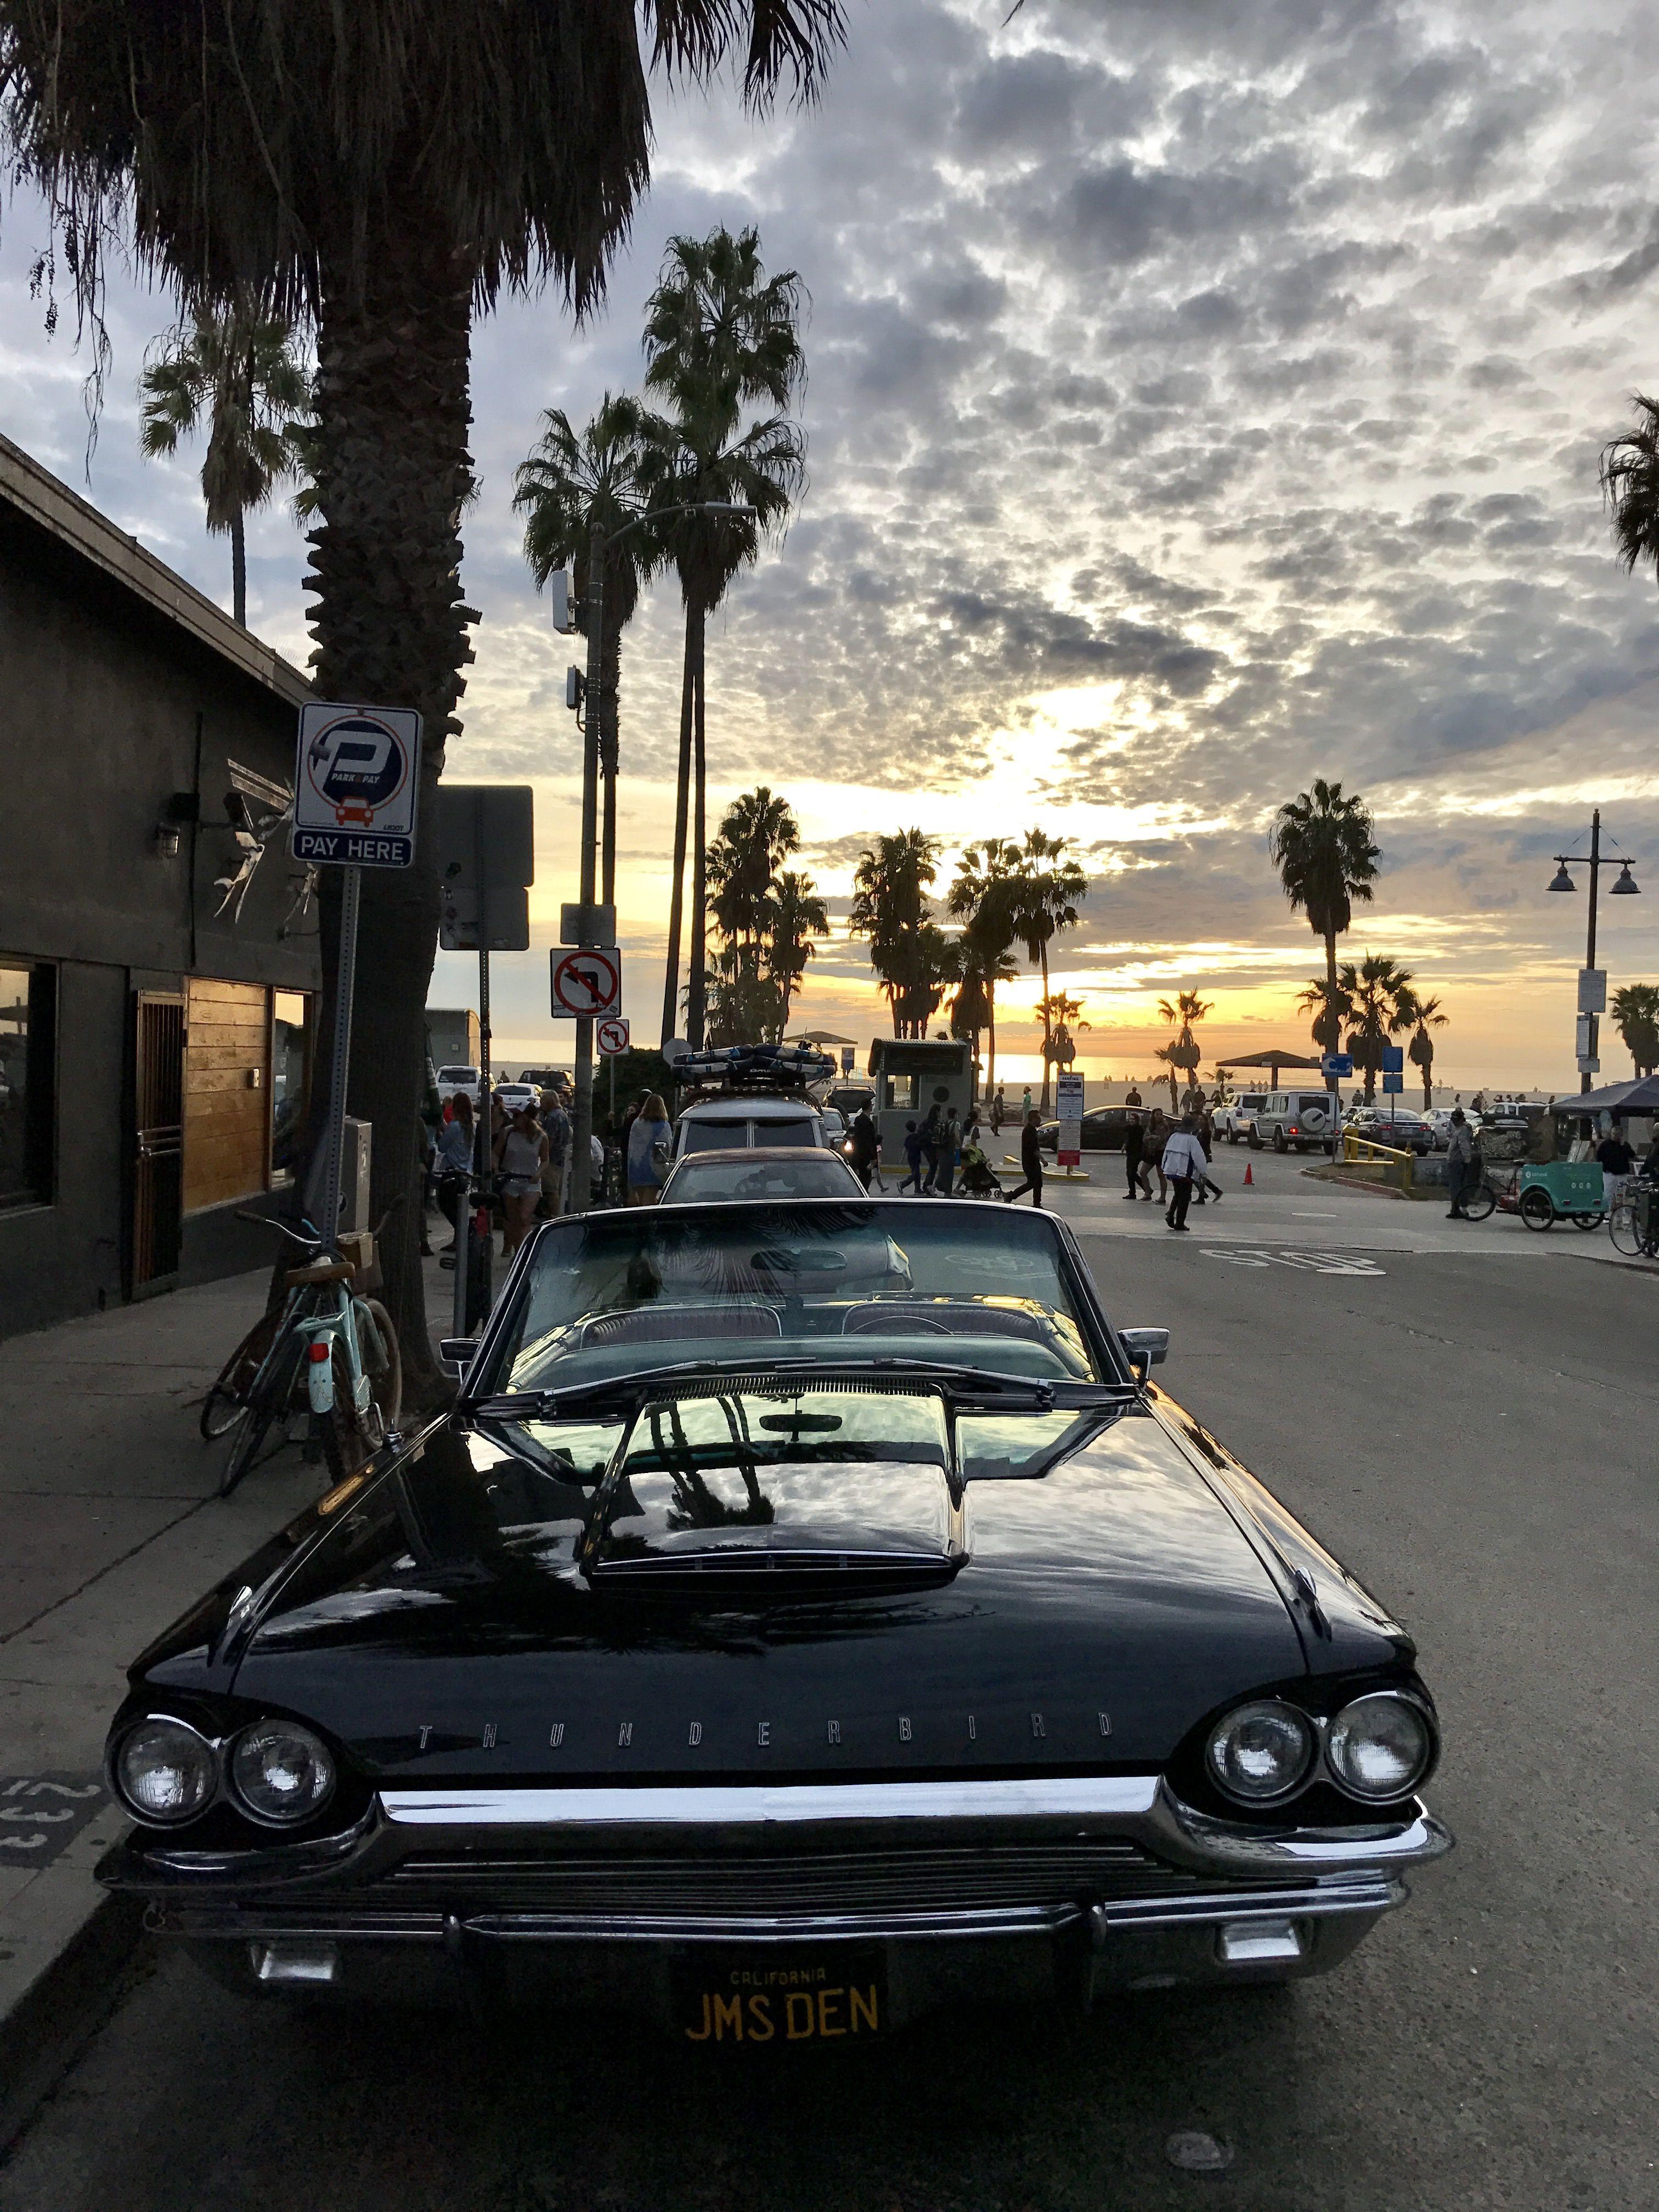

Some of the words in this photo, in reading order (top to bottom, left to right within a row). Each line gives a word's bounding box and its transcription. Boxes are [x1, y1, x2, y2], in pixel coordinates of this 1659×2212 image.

[331, 773, 356, 782] PARK
[362, 775, 381, 784] PAY
[301, 836, 338, 855] PAY
[348, 839, 404, 861] HERE
[1199, 1249, 1386, 1274] STOP
[419, 1712, 1113, 1749] THUNDERBIRD
[730, 1968, 826, 1987] CALIFORNIA
